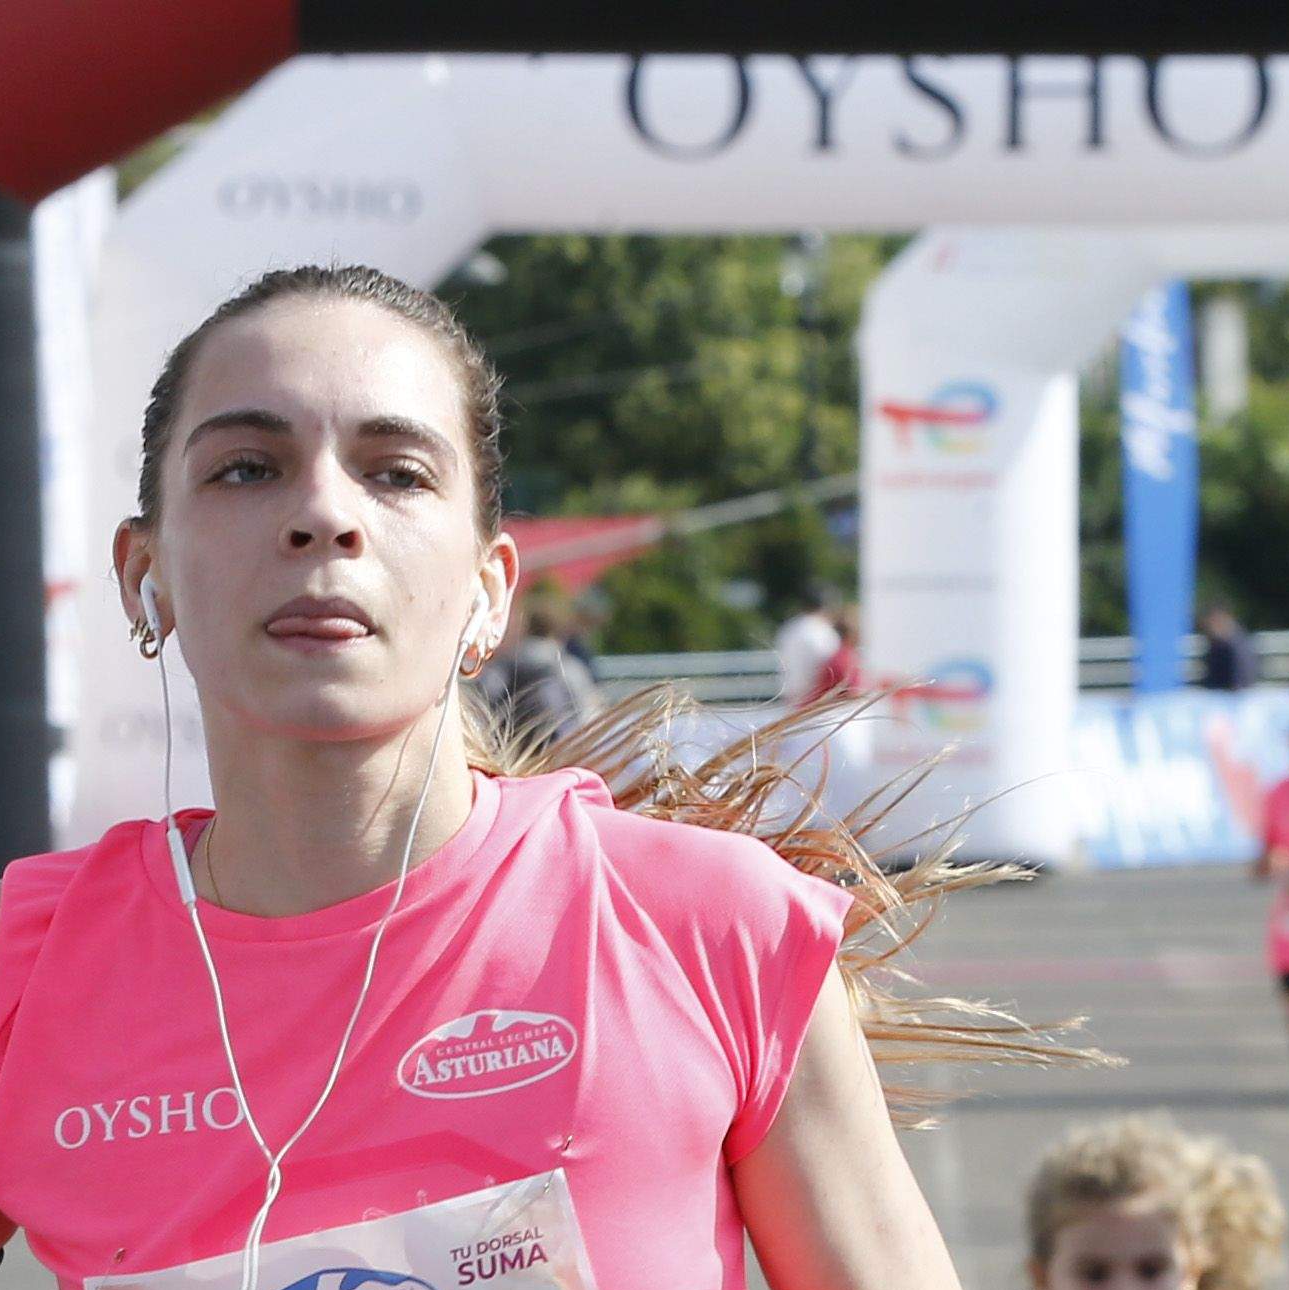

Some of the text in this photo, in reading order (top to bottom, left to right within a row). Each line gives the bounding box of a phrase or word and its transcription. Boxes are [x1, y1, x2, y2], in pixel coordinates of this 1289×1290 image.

[623, 54, 1270, 160] OYSHO
[412, 1036, 567, 1087] ASTURIANA
[436, 1039, 494, 1057] CENTRAL
[54, 1086, 246, 1150] OYSHO
[450, 1227, 544, 1263] TU DORSAL
[458, 1243, 549, 1286] SUMA
